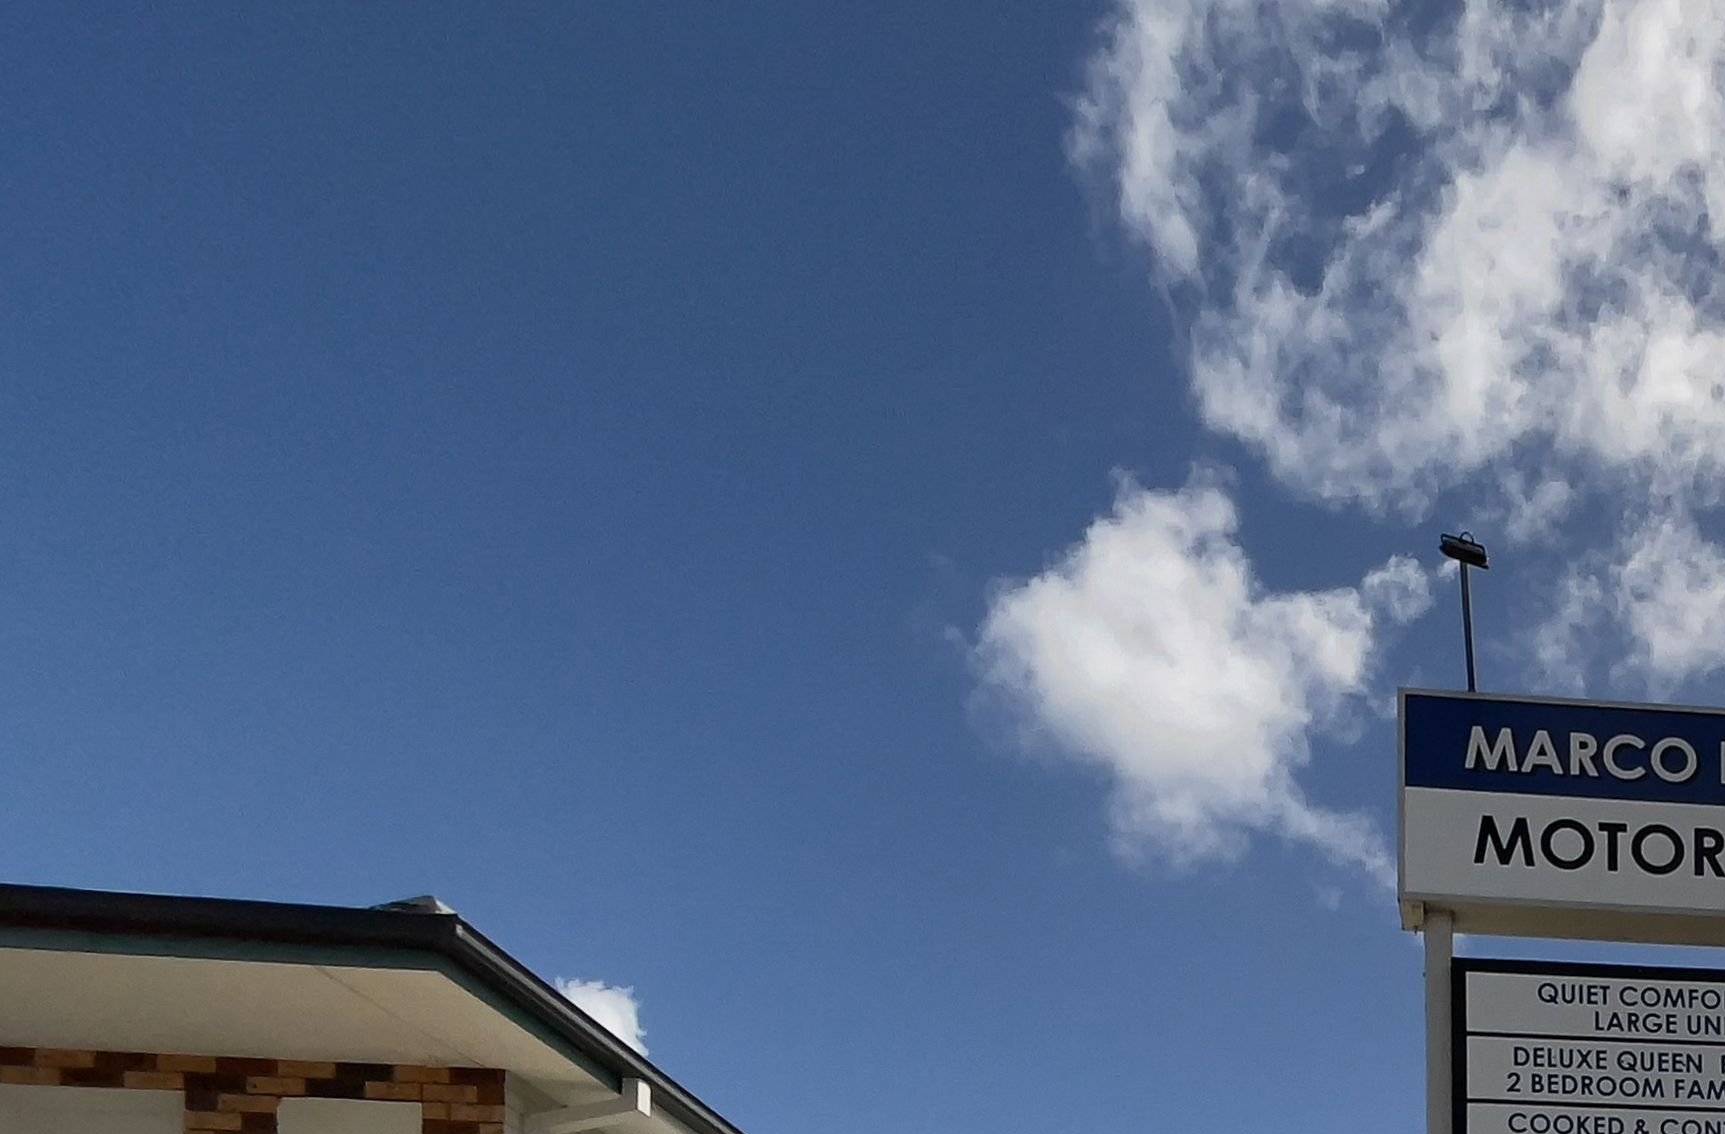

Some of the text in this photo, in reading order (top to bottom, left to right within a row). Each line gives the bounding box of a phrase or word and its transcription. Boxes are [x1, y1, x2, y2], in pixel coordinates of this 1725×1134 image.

[1465, 725, 1697, 783] MARCO
[1537, 982, 1611, 1007] QUIET
[1594, 1011, 1678, 1035] LARGE
[1513, 1046, 1607, 1070] DELUXE
[1617, 1050, 1702, 1074] QUEEN
[1506, 1073, 1521, 1093] 2
[1531, 1074, 1665, 1099] BEDROOM
